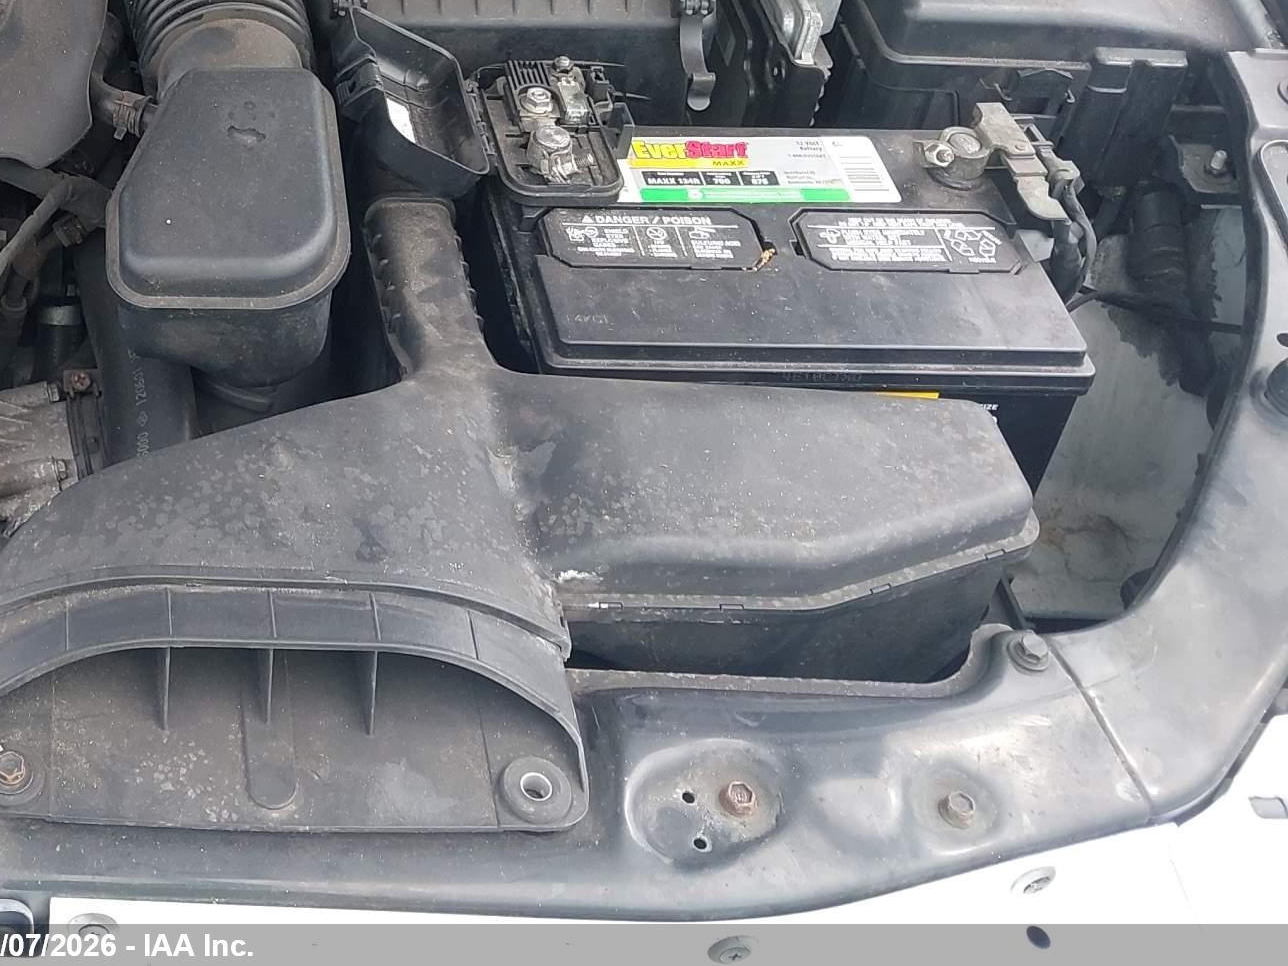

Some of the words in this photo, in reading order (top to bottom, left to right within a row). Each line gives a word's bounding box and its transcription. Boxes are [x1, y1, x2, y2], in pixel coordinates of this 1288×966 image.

[632, 140, 748, 159] EverStart
[647, 177, 677, 185] MAXX
[594, 215, 649, 225] DANGER
[661, 215, 712, 226] POISON
